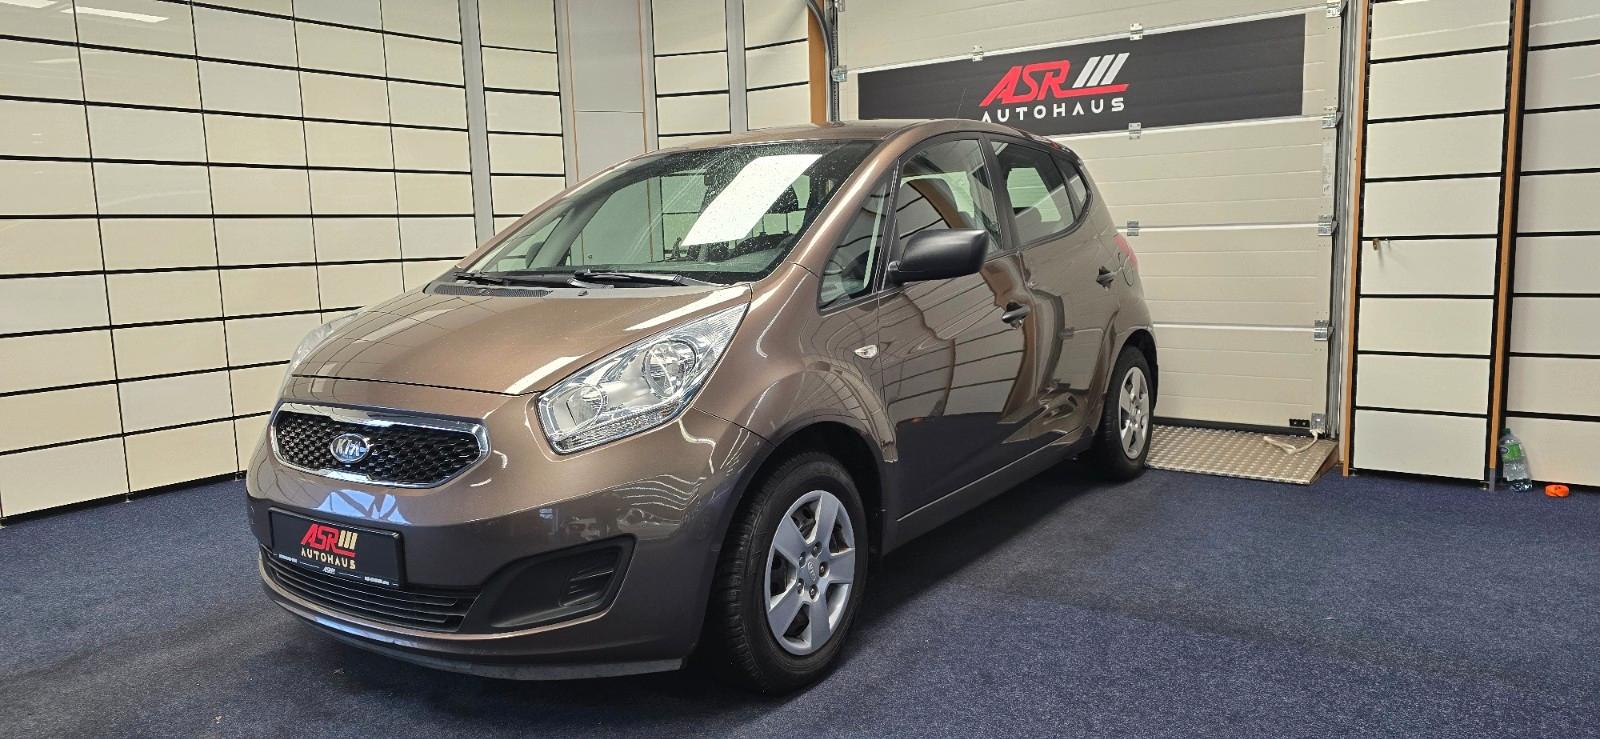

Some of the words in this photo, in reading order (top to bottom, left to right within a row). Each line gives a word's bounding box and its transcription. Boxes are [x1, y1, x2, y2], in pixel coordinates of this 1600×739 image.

[981, 97, 1124, 123] AUTOHAUS
[335, 438, 360, 457] KIA
[301, 547, 356, 570] AUTOHAUS
